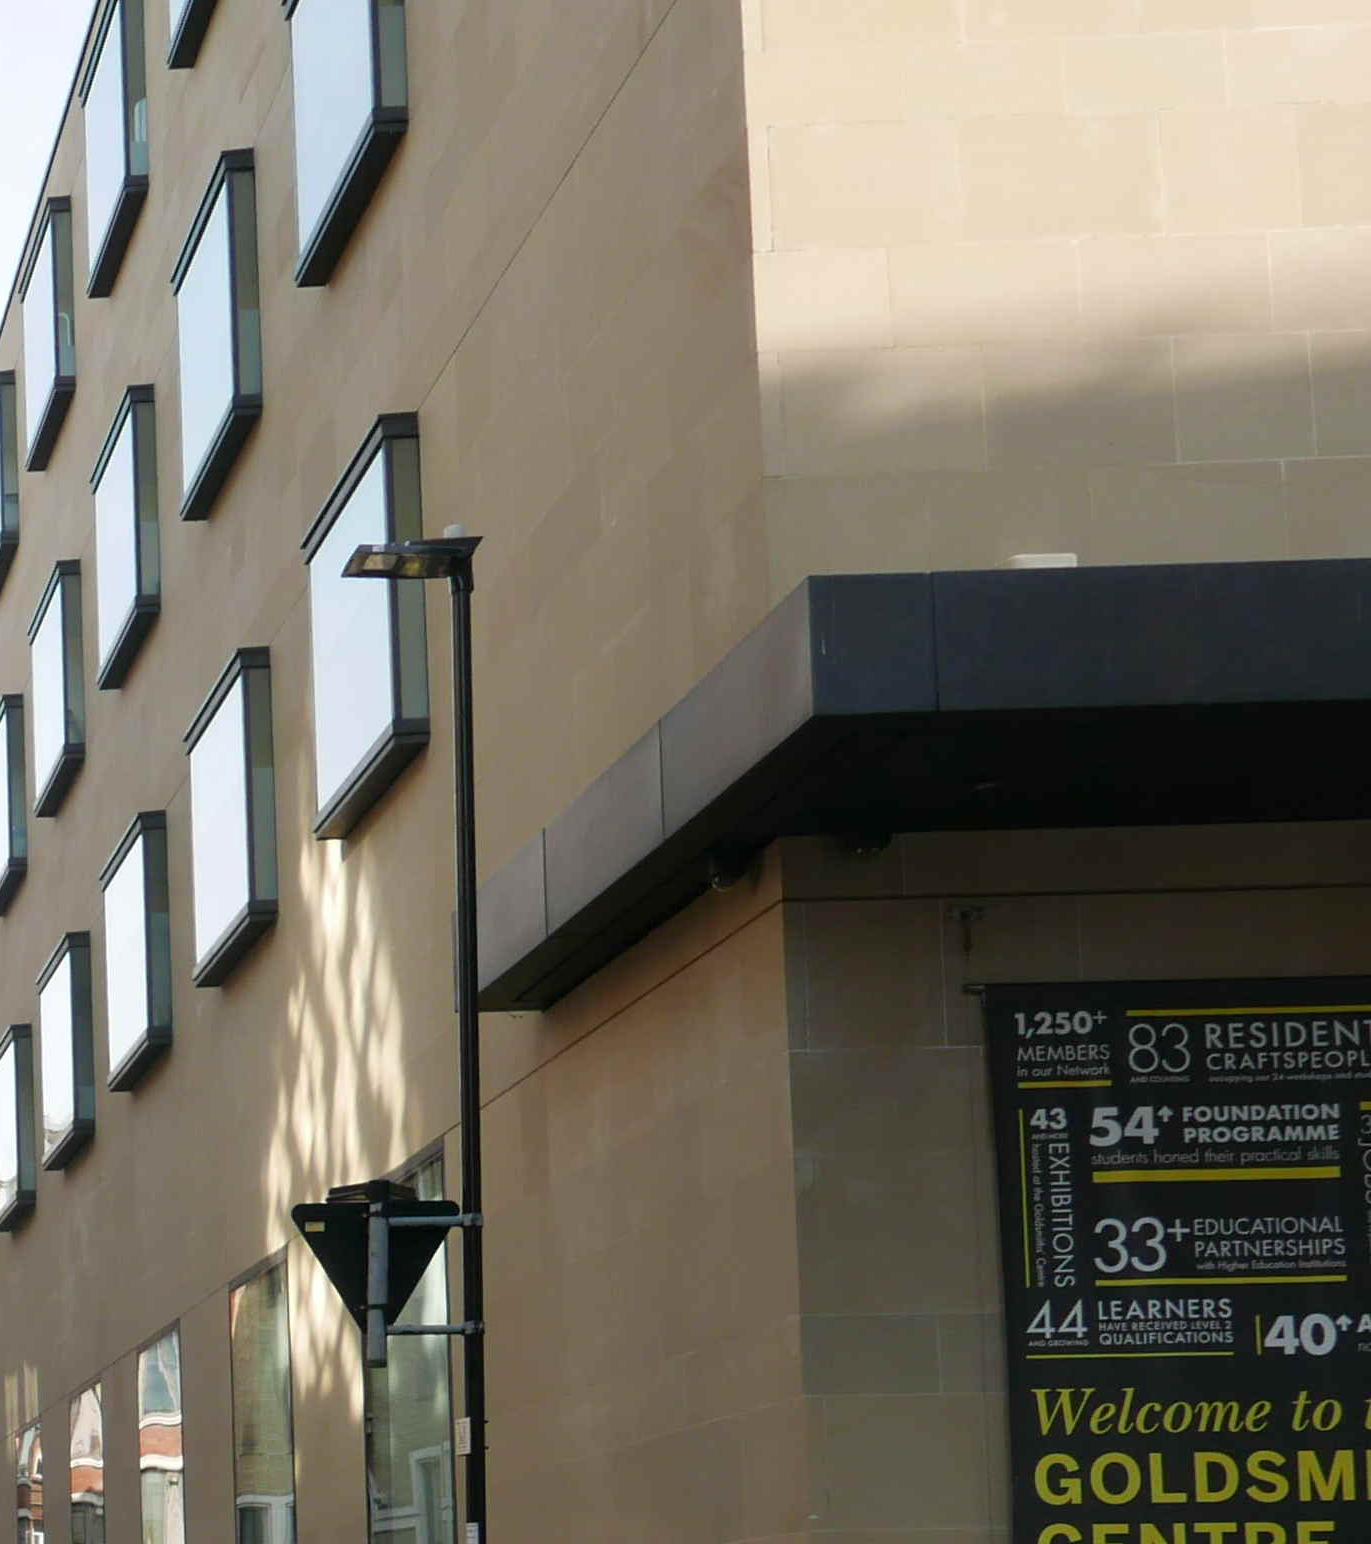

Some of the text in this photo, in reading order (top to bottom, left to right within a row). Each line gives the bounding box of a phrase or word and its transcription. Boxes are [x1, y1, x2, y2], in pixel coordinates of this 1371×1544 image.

[1014, 1010, 1107, 1039] 1,250+
[1017, 1044, 1110, 1061] MEMBERS
[1128, 1023, 1191, 1073] 83
[1017, 1063, 1111, 1078] in our Network
[1030, 1107, 1067, 1131] 43
[1183, 1103, 1339, 1122] FOUNDATION
[1090, 1106, 1159, 1148] 54
[1184, 1123, 1339, 1144] PROGRAMME
[1091, 1146, 1339, 1165] students honed their practical skills
[1048, 1143, 1076, 1288] EXHIBITIONS
[1194, 1216, 1343, 1236] EDUCATIONAL
[1094, 1217, 1190, 1273] 33+
[1195, 1237, 1346, 1258] PARTNERSHIPS
[1026, 1298, 1088, 1339] 44
[1098, 1298, 1233, 1320] LEARNERS
[1098, 1320, 1232, 1332] HAVE RECEIVED LEVEL 2
[1264, 1313, 1337, 1356] 40
[1099, 1331, 1234, 1346] QUALIFICATIONS
[1031, 1387, 1272, 1436] Welcome
[1291, 1390, 1343, 1432] to
